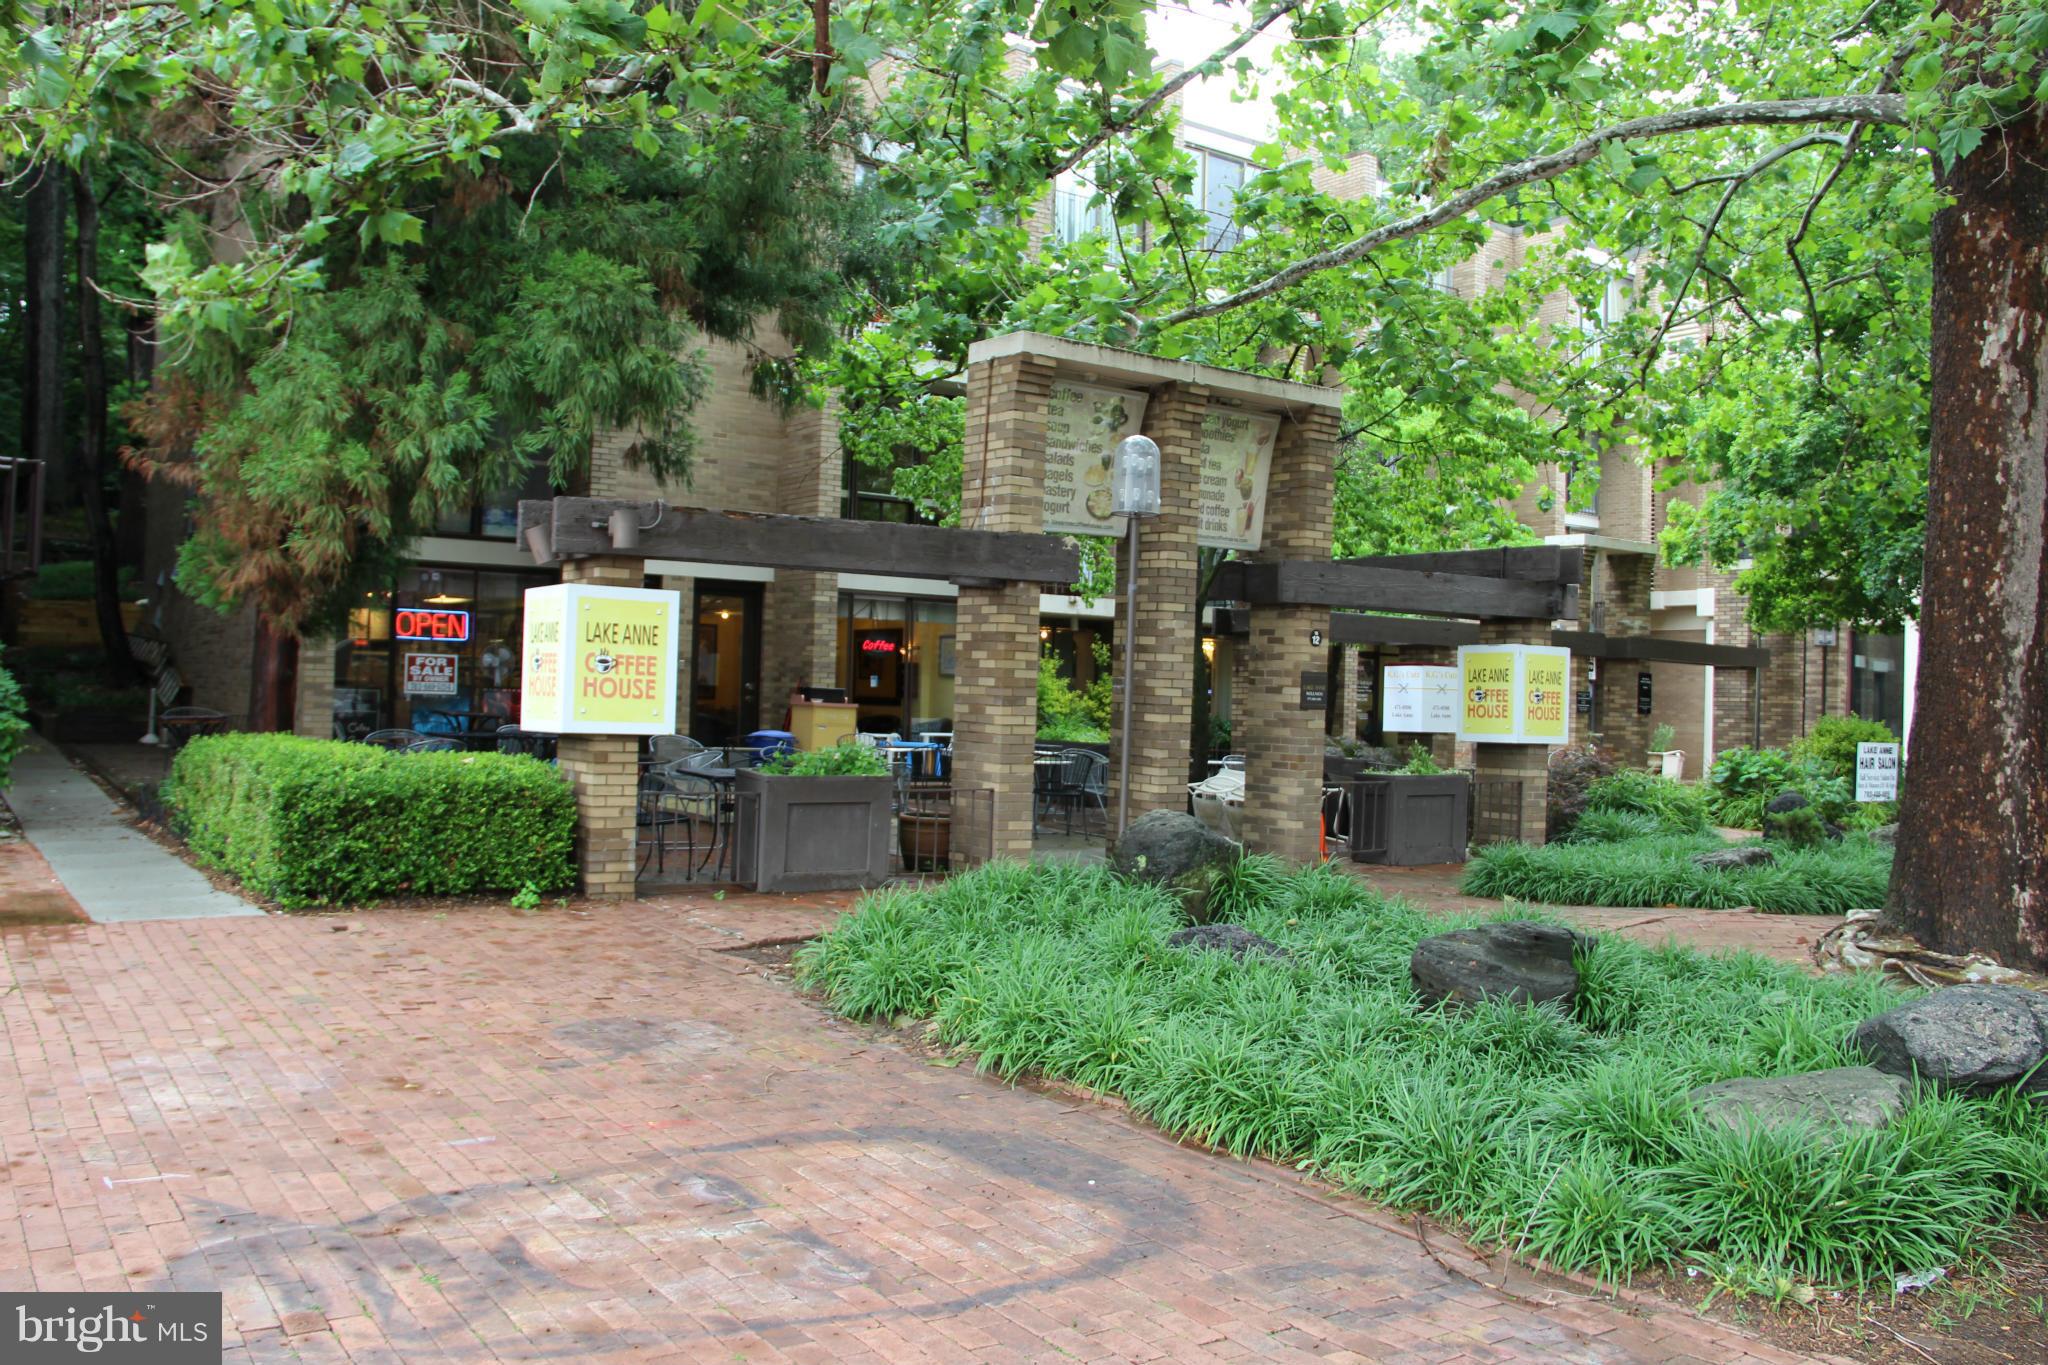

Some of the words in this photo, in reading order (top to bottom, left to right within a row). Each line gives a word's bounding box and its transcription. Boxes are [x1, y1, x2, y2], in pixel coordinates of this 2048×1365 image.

[1048, 401, 1064, 416] tea
[1046, 469, 1074, 483] agels
[1203, 475, 1227, 488] cream
[1043, 501, 1070, 515] ogurt
[1206, 504, 1230, 517] coffee
[1205, 518, 1227, 532] drinks
[395, 611, 465, 638] OPEN
[586, 621, 619, 644] LAKE
[622, 624, 659, 646] ANNE
[1312, 635, 1320, 645] 12
[862, 639, 896, 651] Coffee
[416, 657, 447, 666] FOR
[530, 652, 557, 673] CFFEE
[584, 651, 657, 676] CFFEE
[410, 665, 453, 676] SALE
[1468, 668, 1487, 682] LAKE
[1488, 668, 1509, 682] ANNE
[1528, 670, 1544, 684] LAKE
[1545, 671, 1562, 685] ANNE
[529, 675, 556, 697] HOUSE
[583, 677, 656, 699] HOUSE
[1468, 688, 1509, 703] CFFEE
[1528, 690, 1561, 705] CFFEE
[1467, 704, 1508, 718] HOUSE
[1528, 706, 1560, 720] HOUSE
[1863, 746, 1877, 754] LAKE
[1879, 746, 1893, 754] ANNE
[1859, 757, 1874, 769] HAIR
[1878, 757, 1896, 769] SALON
